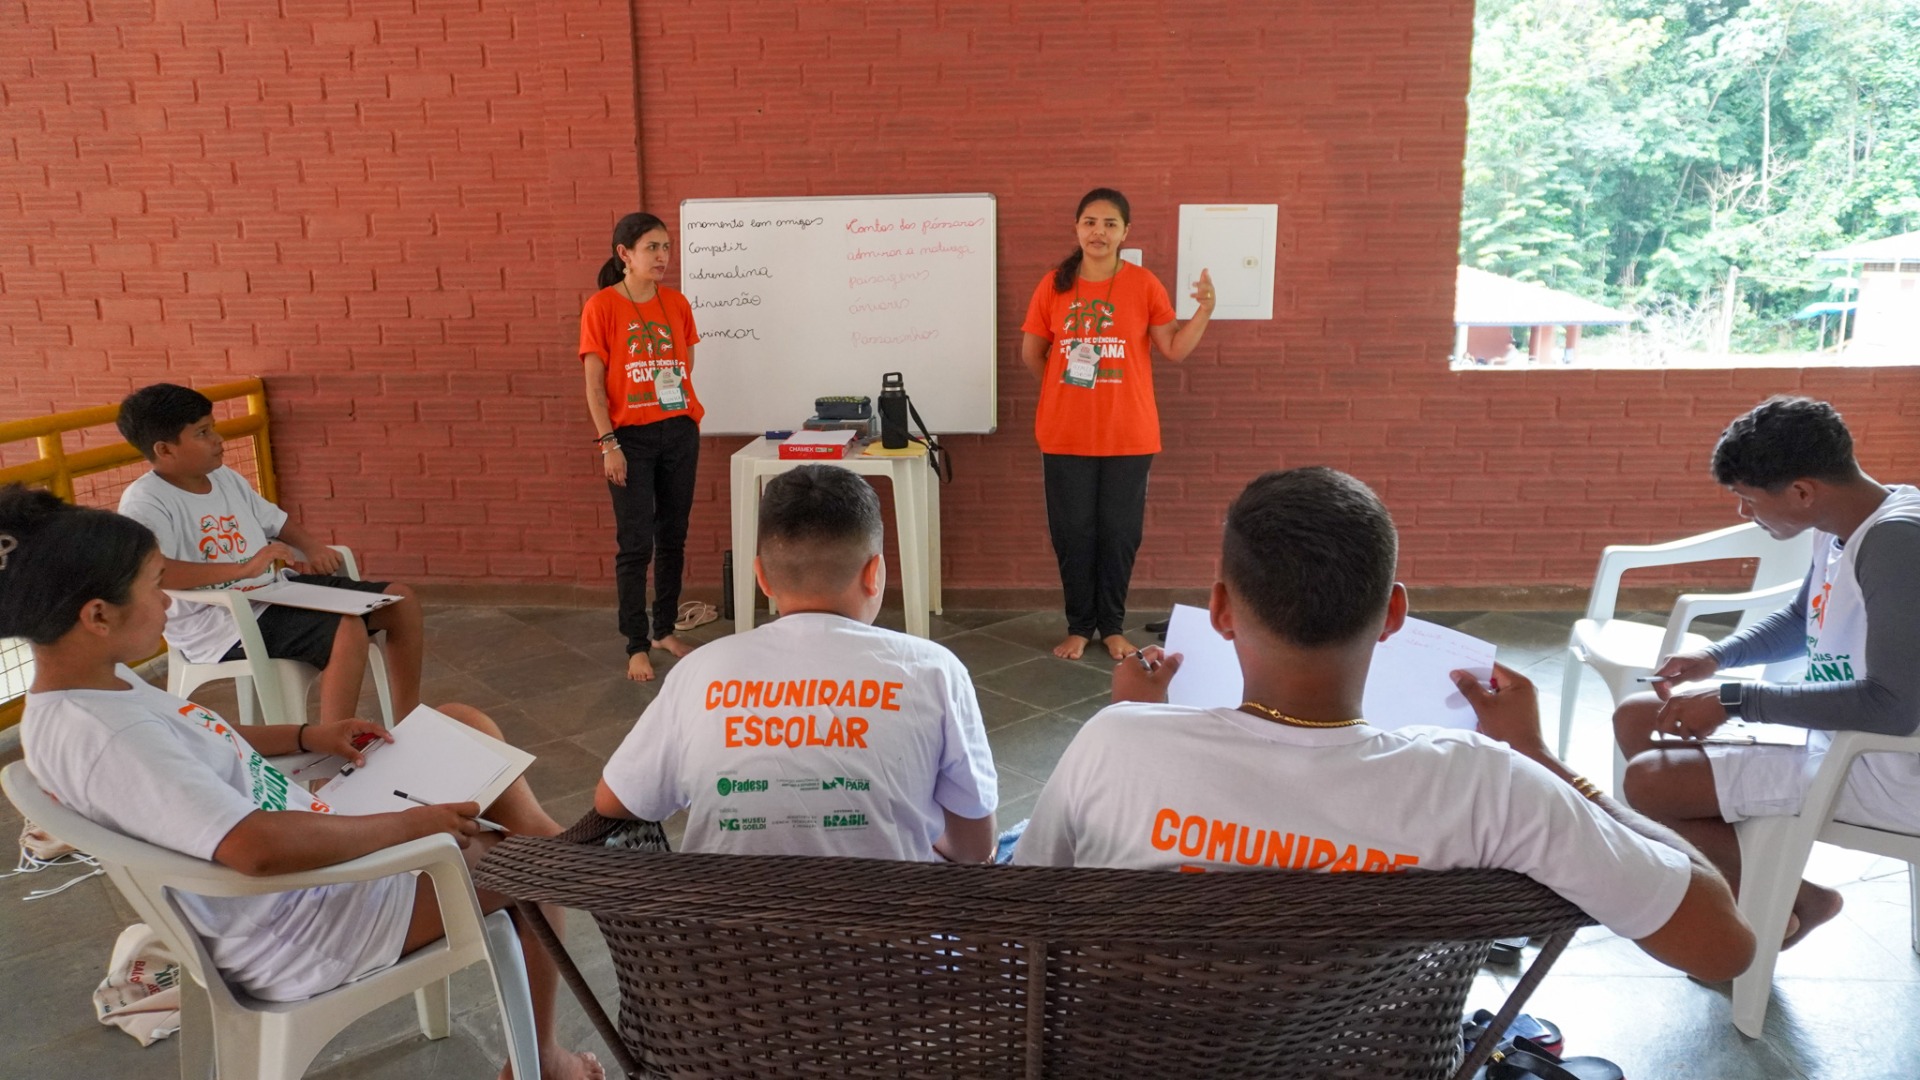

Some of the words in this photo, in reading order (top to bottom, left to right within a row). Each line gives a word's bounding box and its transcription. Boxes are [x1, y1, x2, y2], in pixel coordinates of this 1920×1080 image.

[689, 265, 773, 280] adrenalina
[699, 328, 760, 341] rincar
[705, 679, 903, 711] COMUNIDADE
[725, 715, 869, 749] ESCOLAR
[732, 779, 769, 792] Fadesp
[823, 814, 869, 828] BRASIL
